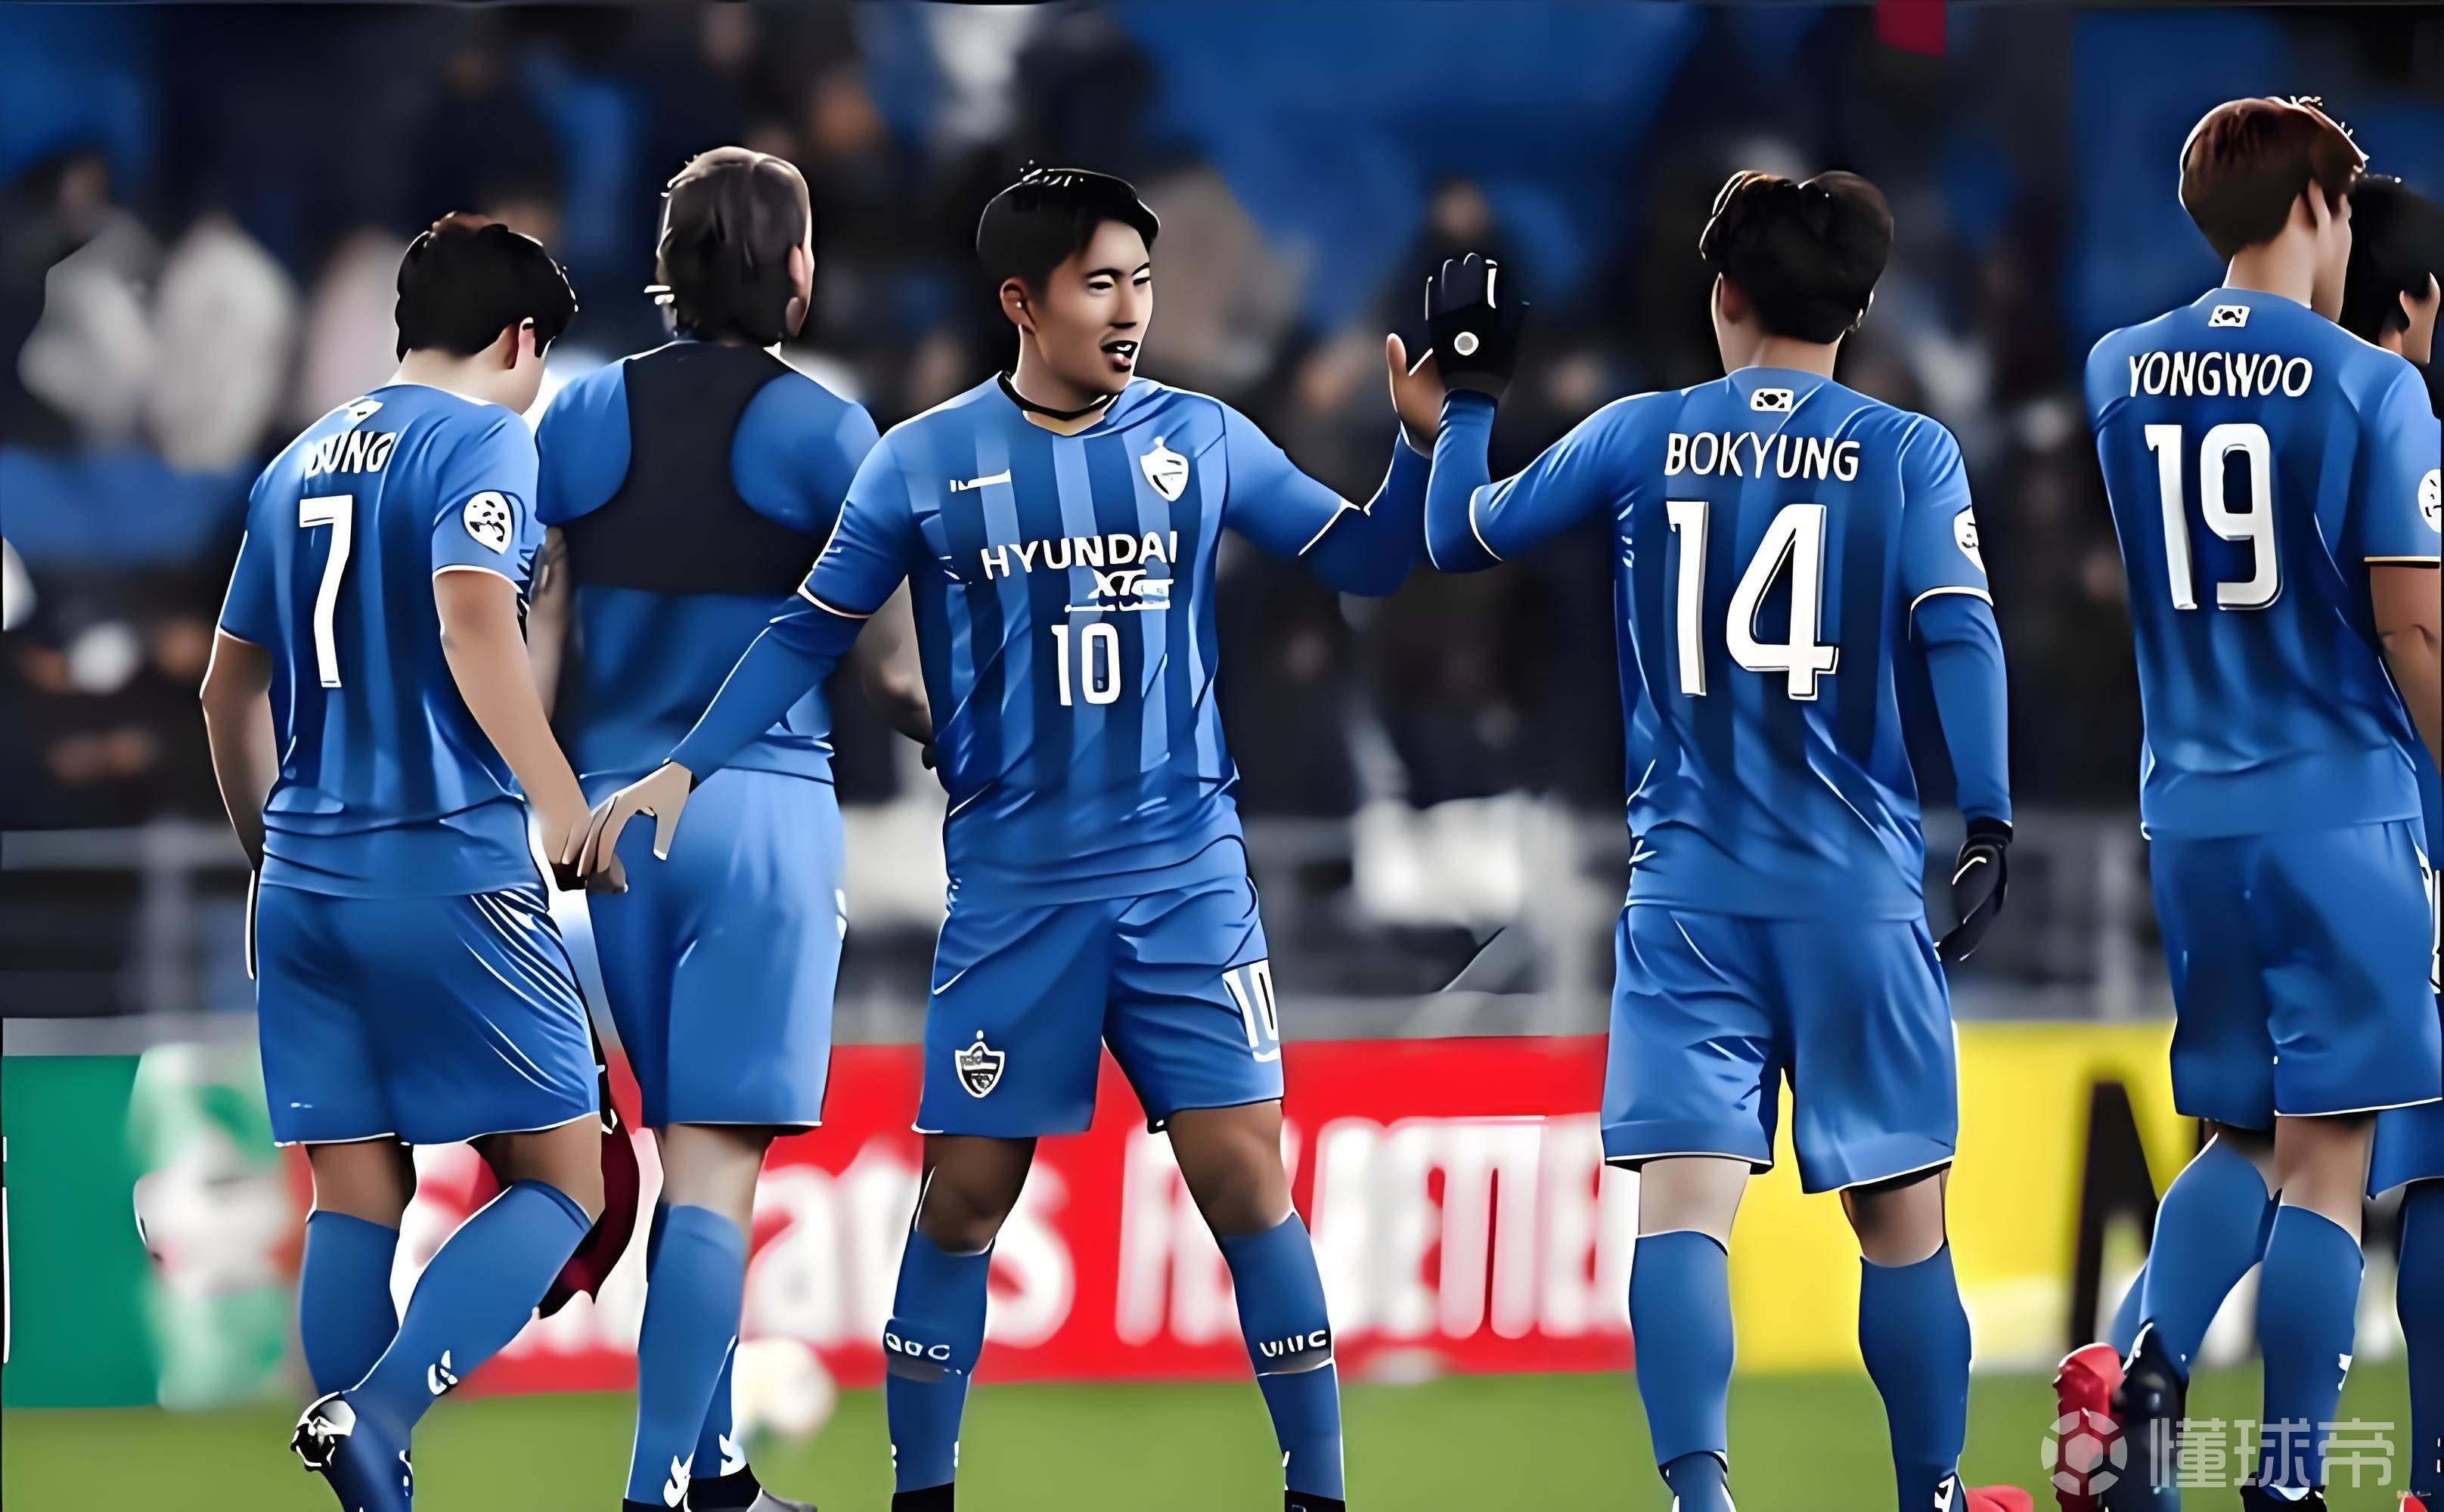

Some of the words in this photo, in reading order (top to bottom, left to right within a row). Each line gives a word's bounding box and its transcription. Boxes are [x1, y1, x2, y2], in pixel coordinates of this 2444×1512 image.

[2129, 351, 2313, 398] YONGWOO
[1664, 432, 1860, 482] BOKYUNG
[980, 531, 1177, 580] HYUNDAI
[2144, 423, 2283, 611] 19
[299, 494, 353, 688] 7
[1666, 501, 1839, 701] 14
[1051, 622, 1121, 706] 10
